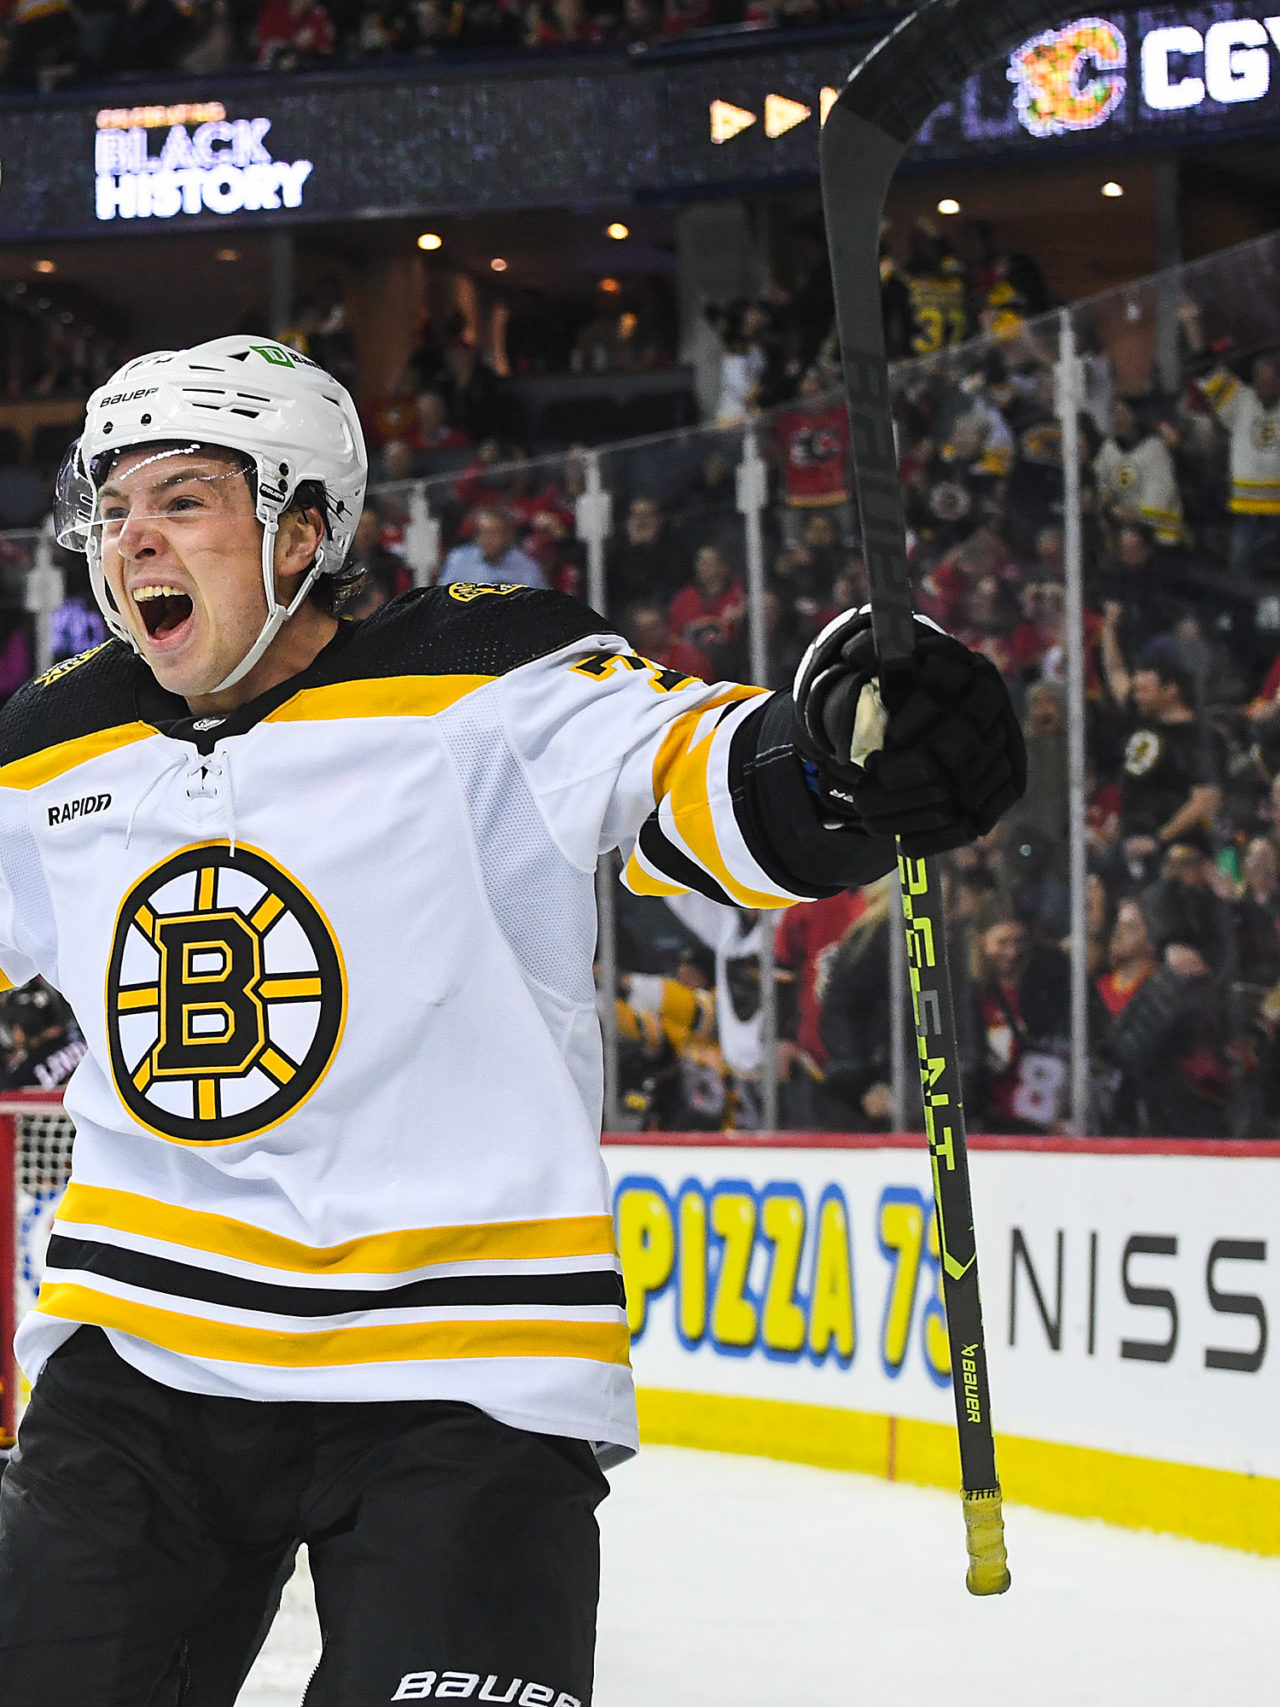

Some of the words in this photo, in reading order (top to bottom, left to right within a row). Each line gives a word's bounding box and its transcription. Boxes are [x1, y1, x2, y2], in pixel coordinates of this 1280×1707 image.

[1141, 17, 1280, 110] CG
[95, 117, 272, 176] BLACK
[95, 159, 315, 220] HISTORY
[152, 911, 266, 1077] B
[612, 1180, 855, 1365] PIZZA
[1008, 1228, 1269, 1374] NISS
[962, 1358, 982, 1424] BAUER
